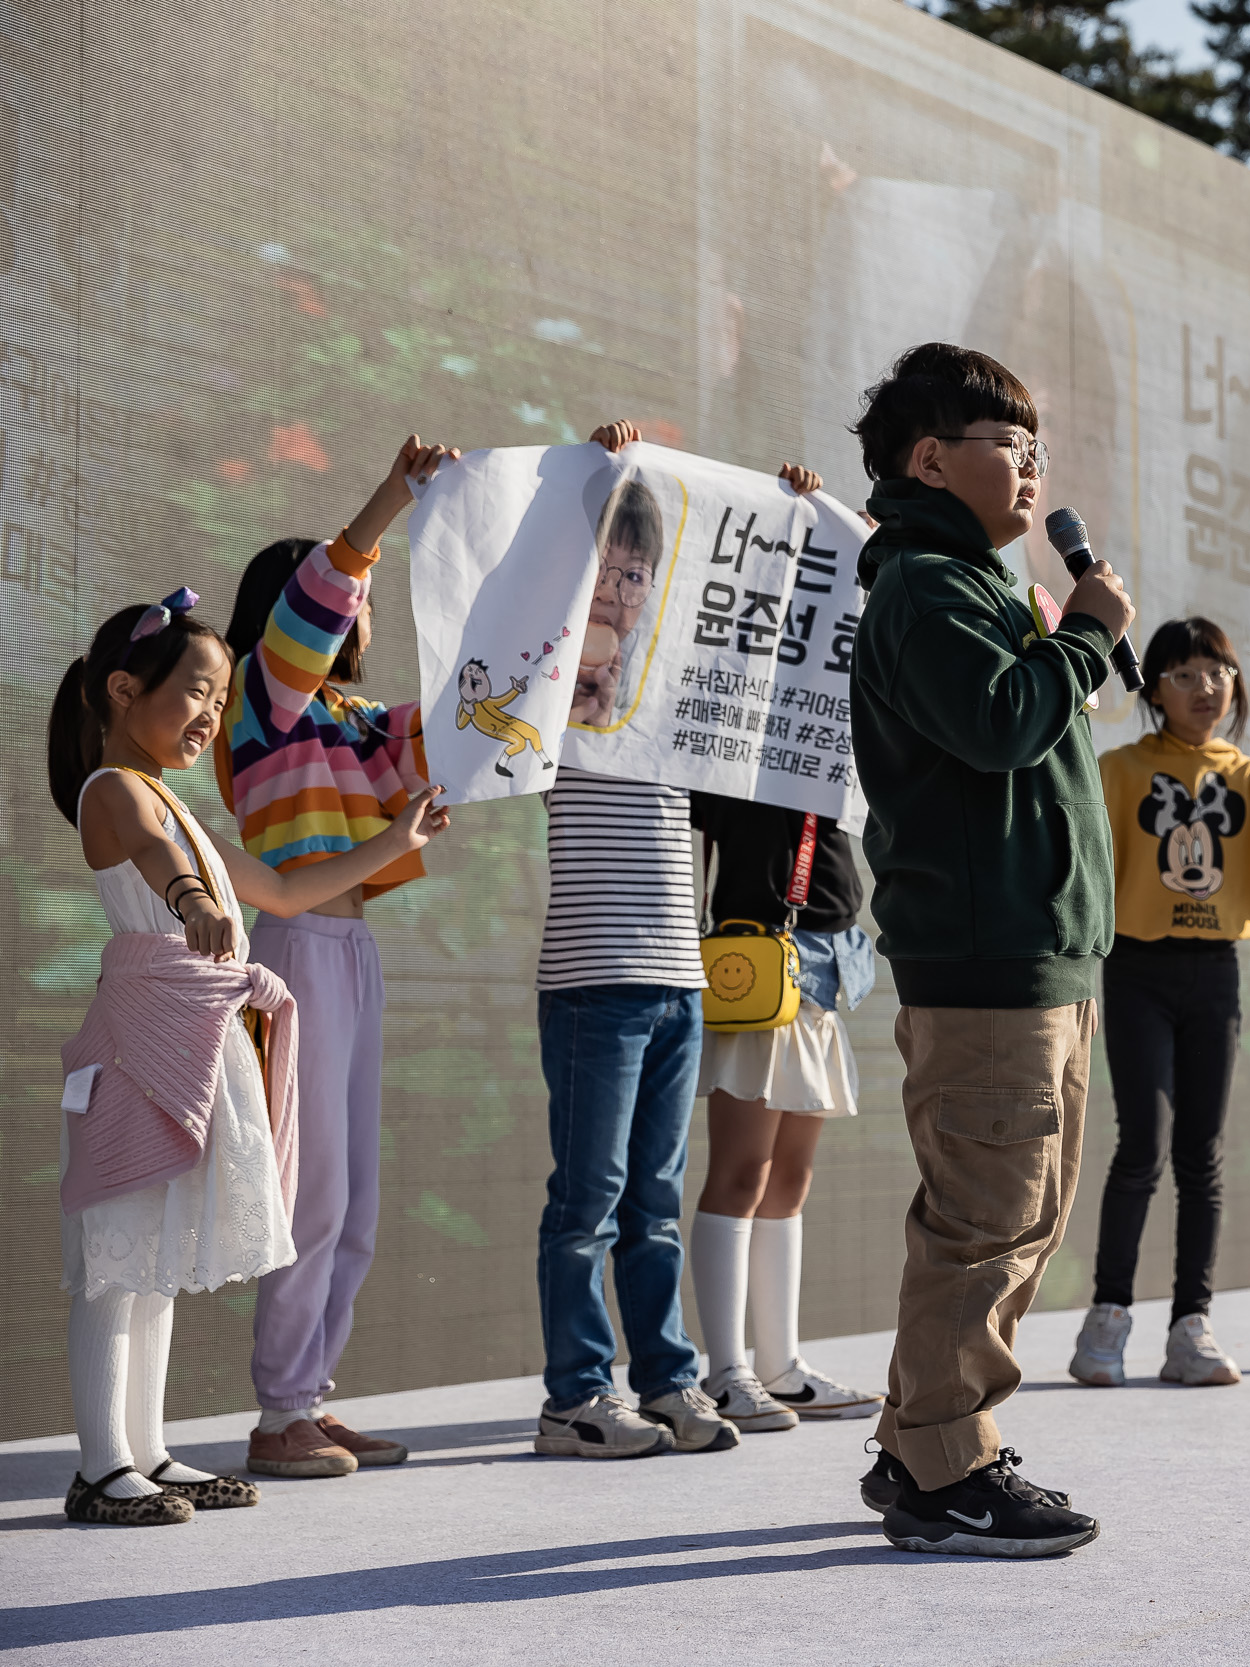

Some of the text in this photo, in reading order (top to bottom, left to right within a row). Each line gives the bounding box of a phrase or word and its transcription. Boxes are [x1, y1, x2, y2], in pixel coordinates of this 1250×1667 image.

[694, 580, 818, 667] 윤준성
[675, 697, 742, 729] #매력에
[673, 729, 751, 763] #떨지말자
[1171, 915, 1221, 931] MOUSE
[1173, 902, 1217, 915] MINNIE
